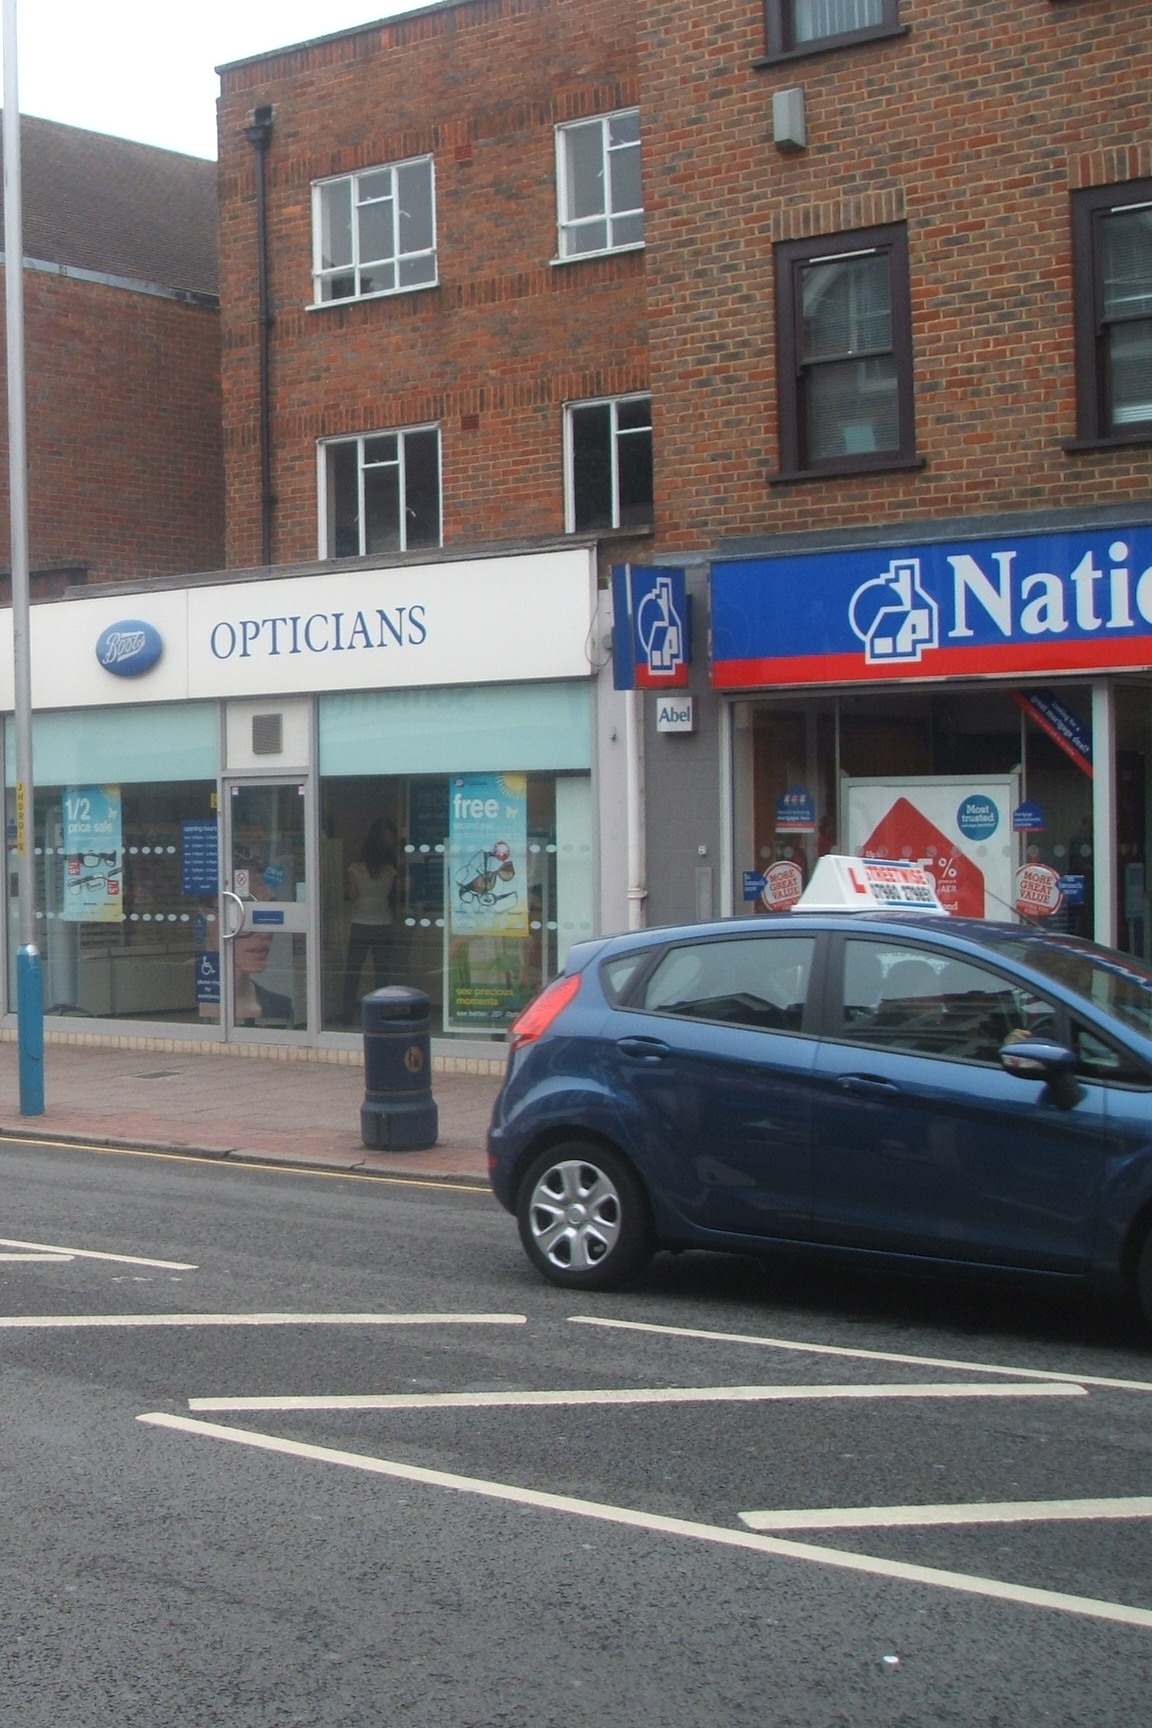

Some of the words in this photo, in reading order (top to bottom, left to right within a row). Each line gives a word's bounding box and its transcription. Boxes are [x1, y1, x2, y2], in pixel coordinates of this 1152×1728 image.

[210, 604, 427, 660] OPTICIANS
[102, 630, 147, 665] Boots
[659, 705, 691, 722] Abel
[65, 797, 91, 821] 1/2
[454, 793, 499, 818] free
[966, 804, 990, 814] Most
[961, 812, 994, 823] trusted
[68, 821, 91, 833] price
[94, 820, 113, 833] sale
[769, 870, 794, 880] MORE
[848, 867, 866, 894] L
[1023, 872, 1053, 885] MORE
[770, 879, 797, 891] GREAT
[1019, 880, 1052, 895] GREAT
[773, 887, 799, 900] VALUE
[1019, 889, 1050, 904] VALUE
[456, 988, 472, 996] see
[475, 988, 514, 998] precious
[455, 998, 499, 1006] moments
